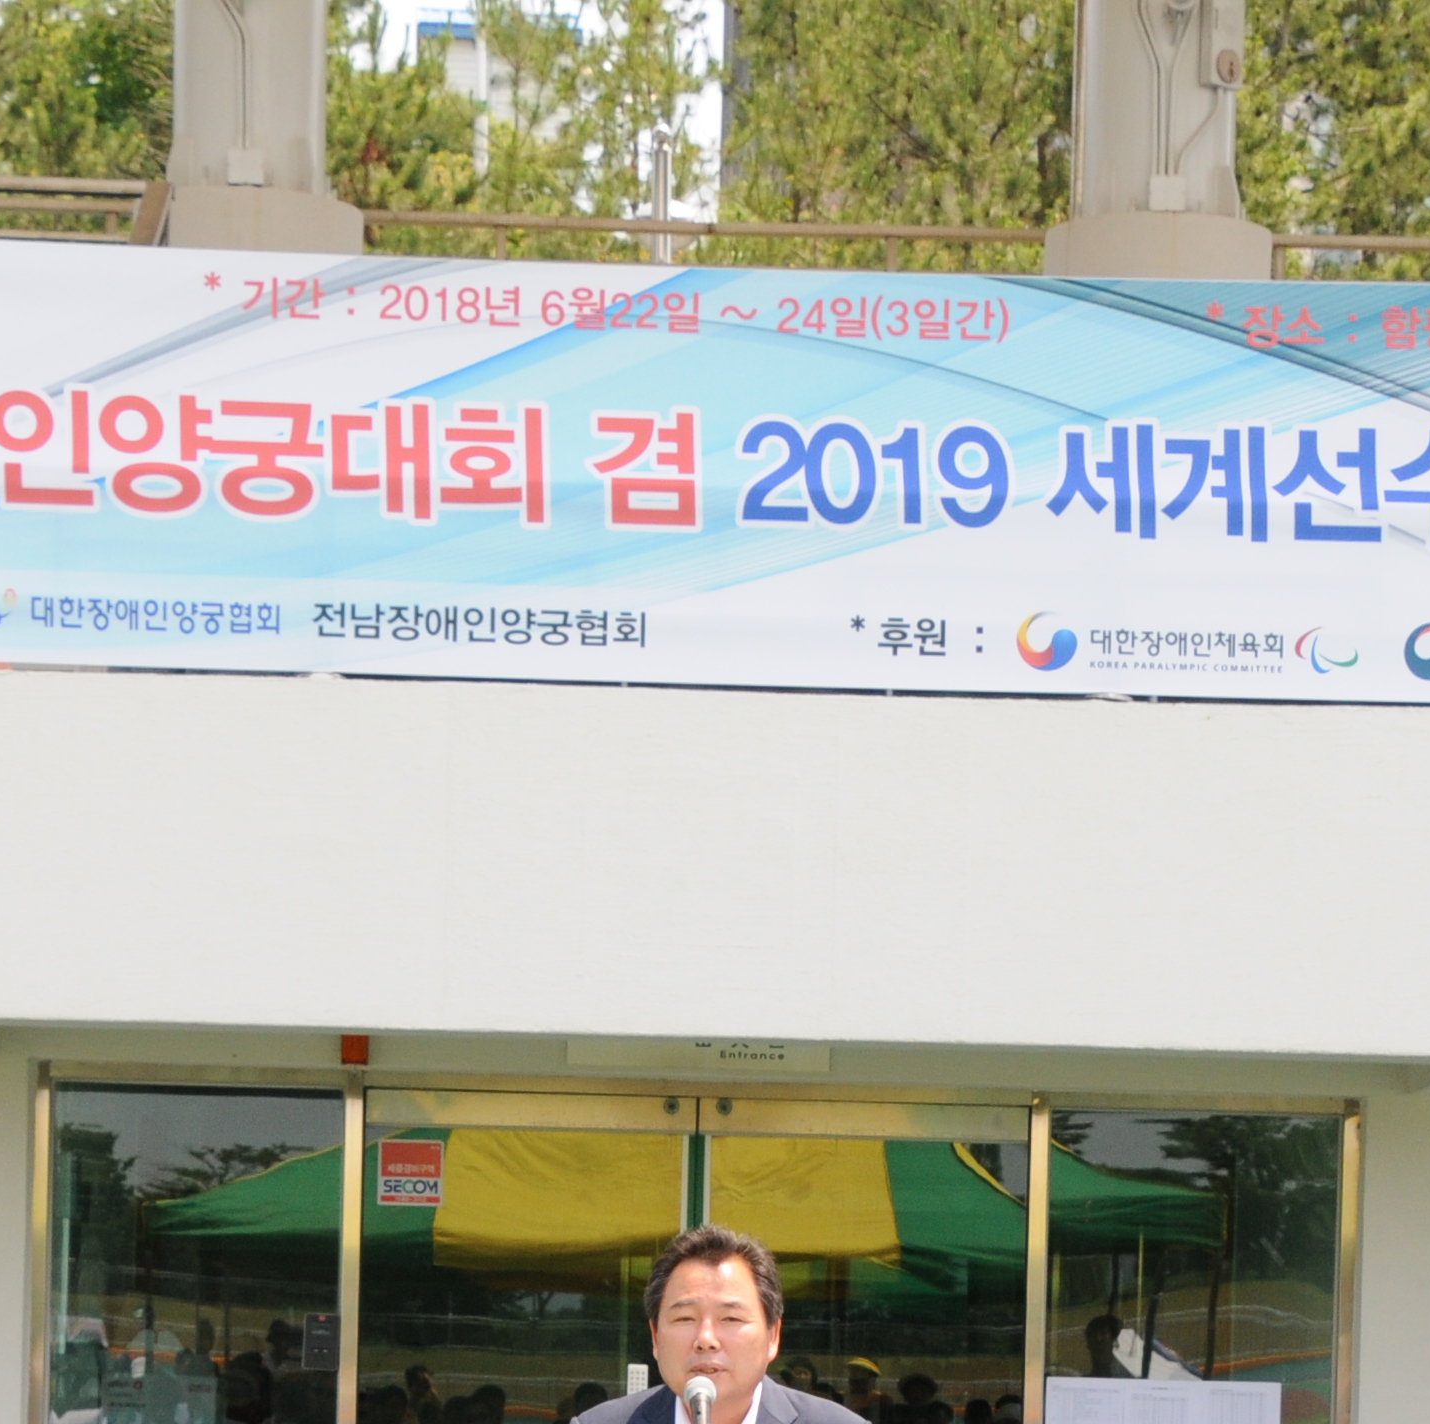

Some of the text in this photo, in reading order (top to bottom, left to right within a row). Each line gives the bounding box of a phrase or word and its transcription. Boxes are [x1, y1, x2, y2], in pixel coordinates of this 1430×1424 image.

[242, 276, 326, 320] 기간
[378, 283, 522, 328] 2018년
[540, 286, 700, 333] 6월22일
[776, 294, 1011, 343] 24일(3일간)
[1241, 304, 1326, 350] 장소
[592, 410, 698, 528] 겸
[741, 421, 1009, 529] 2019
[30, 595, 282, 636] 대한장애인양궁협회
[311, 601, 647, 649] 전남장애인양궁협회
[876, 617, 947, 658] 후원
[1089, 627, 1285, 660] 대한장애인체육회
[1089, 660, 1284, 674] KOREA PARALYMPIC COMMITTEE
[719, 1050, 785, 1061] Entrance
[383, 1179, 439, 1195] SECOM
